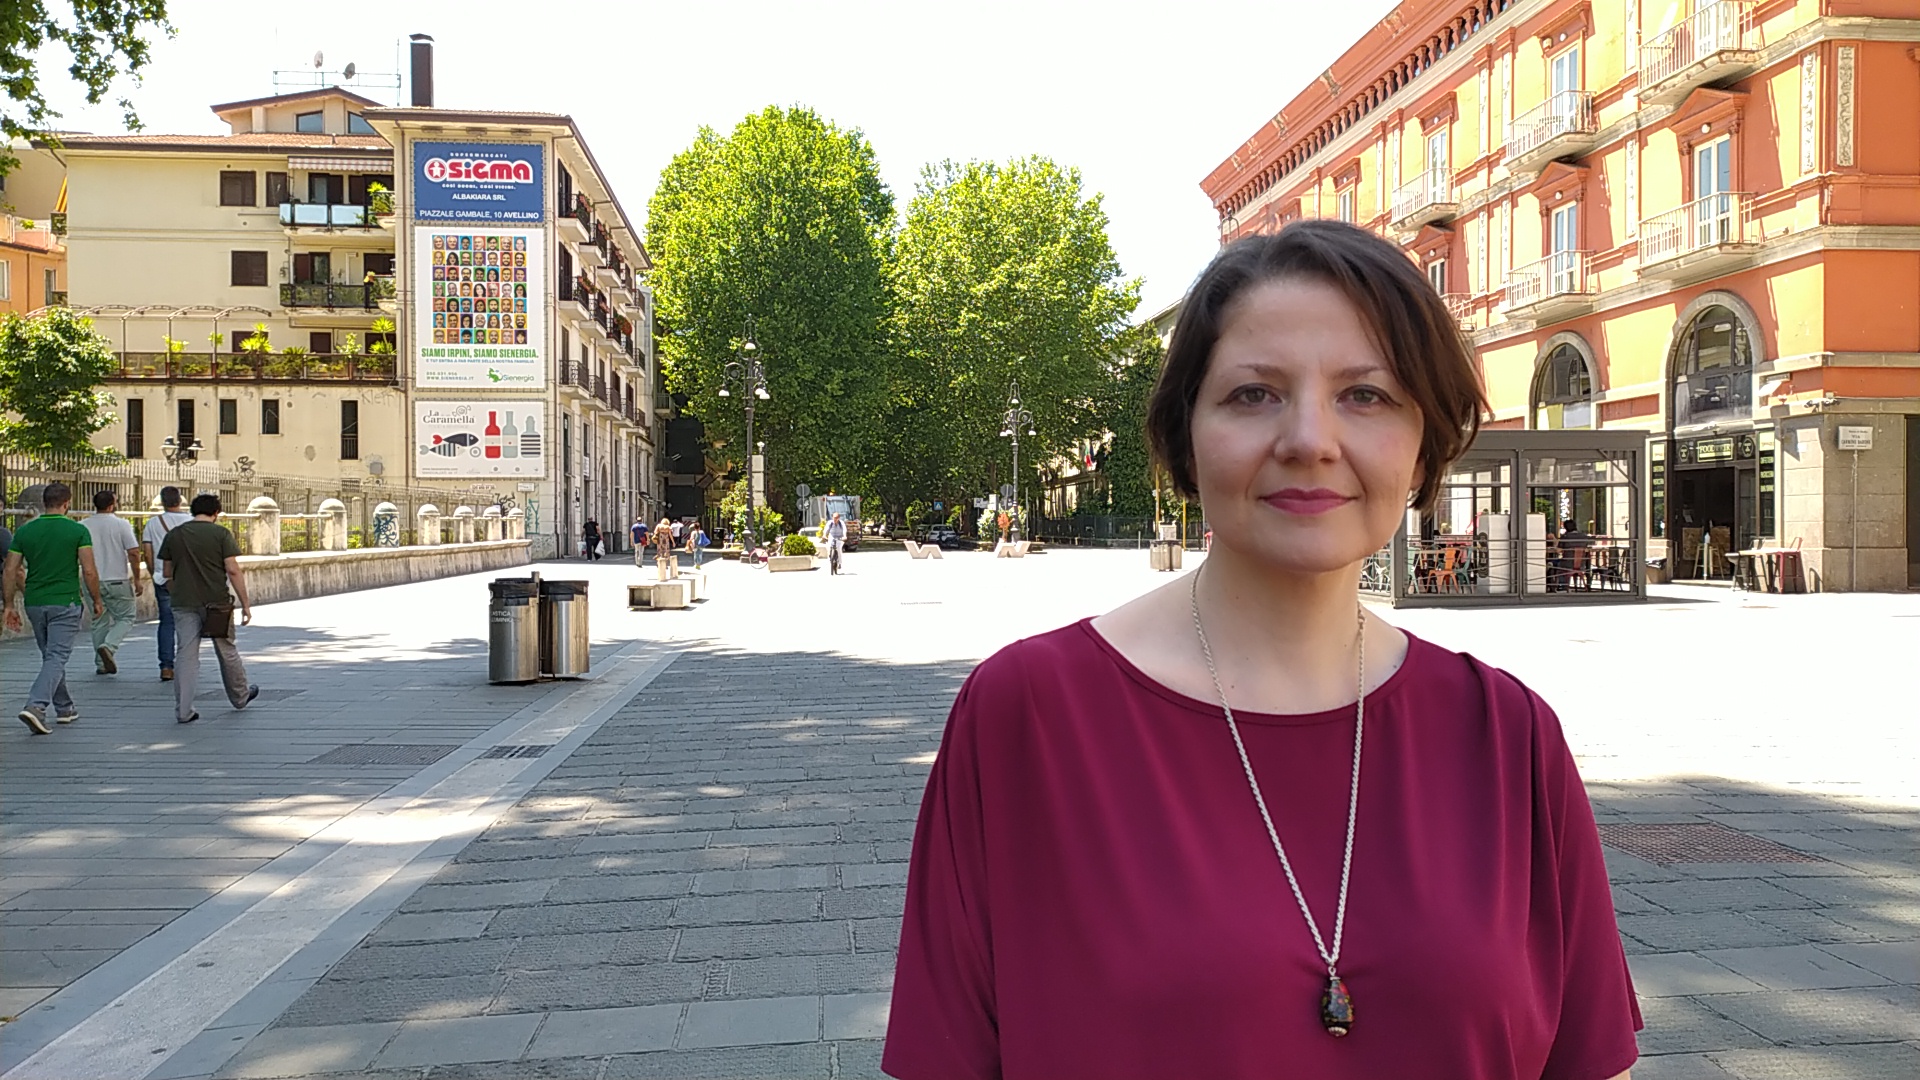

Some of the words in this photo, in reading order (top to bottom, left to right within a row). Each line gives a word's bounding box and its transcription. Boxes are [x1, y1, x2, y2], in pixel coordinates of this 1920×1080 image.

[419, 210, 454, 218] PIAZZALE
[455, 211, 493, 219] GAMBALE,
[503, 211, 540, 219] AVELLINO
[421, 348, 446, 358] SIAMO
[447, 348, 472, 358] IRPINI,
[474, 348, 497, 358] SIAMO
[499, 348, 540, 358] SIENERGIA.
[502, 374, 535, 383] Sienergia
[423, 416, 475, 424] Caramella
